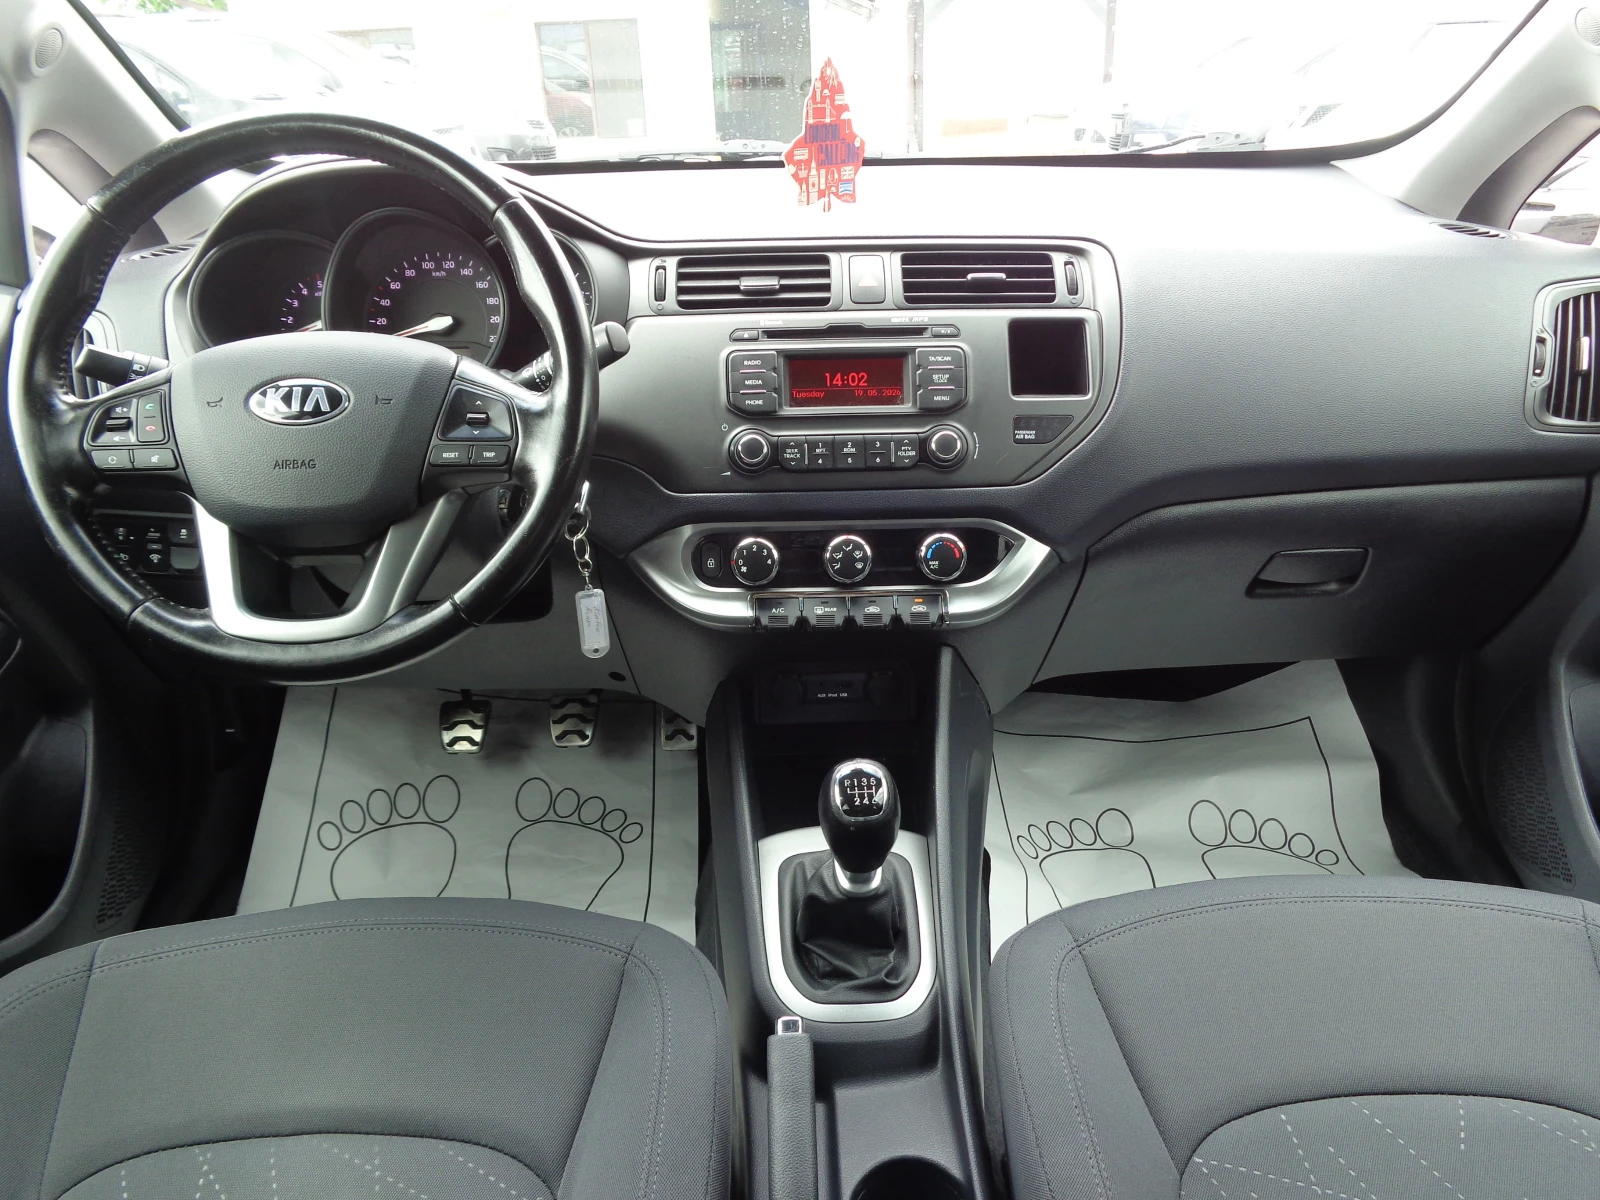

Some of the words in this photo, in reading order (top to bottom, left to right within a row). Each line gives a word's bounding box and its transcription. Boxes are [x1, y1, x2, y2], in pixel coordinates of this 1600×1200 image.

[804, 123, 841, 144] LONDON
[422, 261, 434, 269] 100
[442, 260, 454, 268] 120
[405, 269, 415, 277] 80
[460, 268, 473, 276] 140
[317, 280, 323, 288] 5
[390, 281, 401, 289] 60
[475, 281, 489, 289] 160
[292, 299, 299, 307] 3
[486, 297, 499, 305] 180
[287, 316, 294, 324] 2
[376, 317, 387, 325] 20
[824, 372, 868, 387] 14:02
[792, 390, 825, 399] Tuesday
[264, 386, 331, 412] KIA
[273, 459, 317, 470] AIRBAG
[844, 779, 850, 787] R
[861, 777, 868, 785] 3
[870, 777, 876, 785] 5
[854, 797, 860, 805] 2
[862, 797, 869, 805] 4
